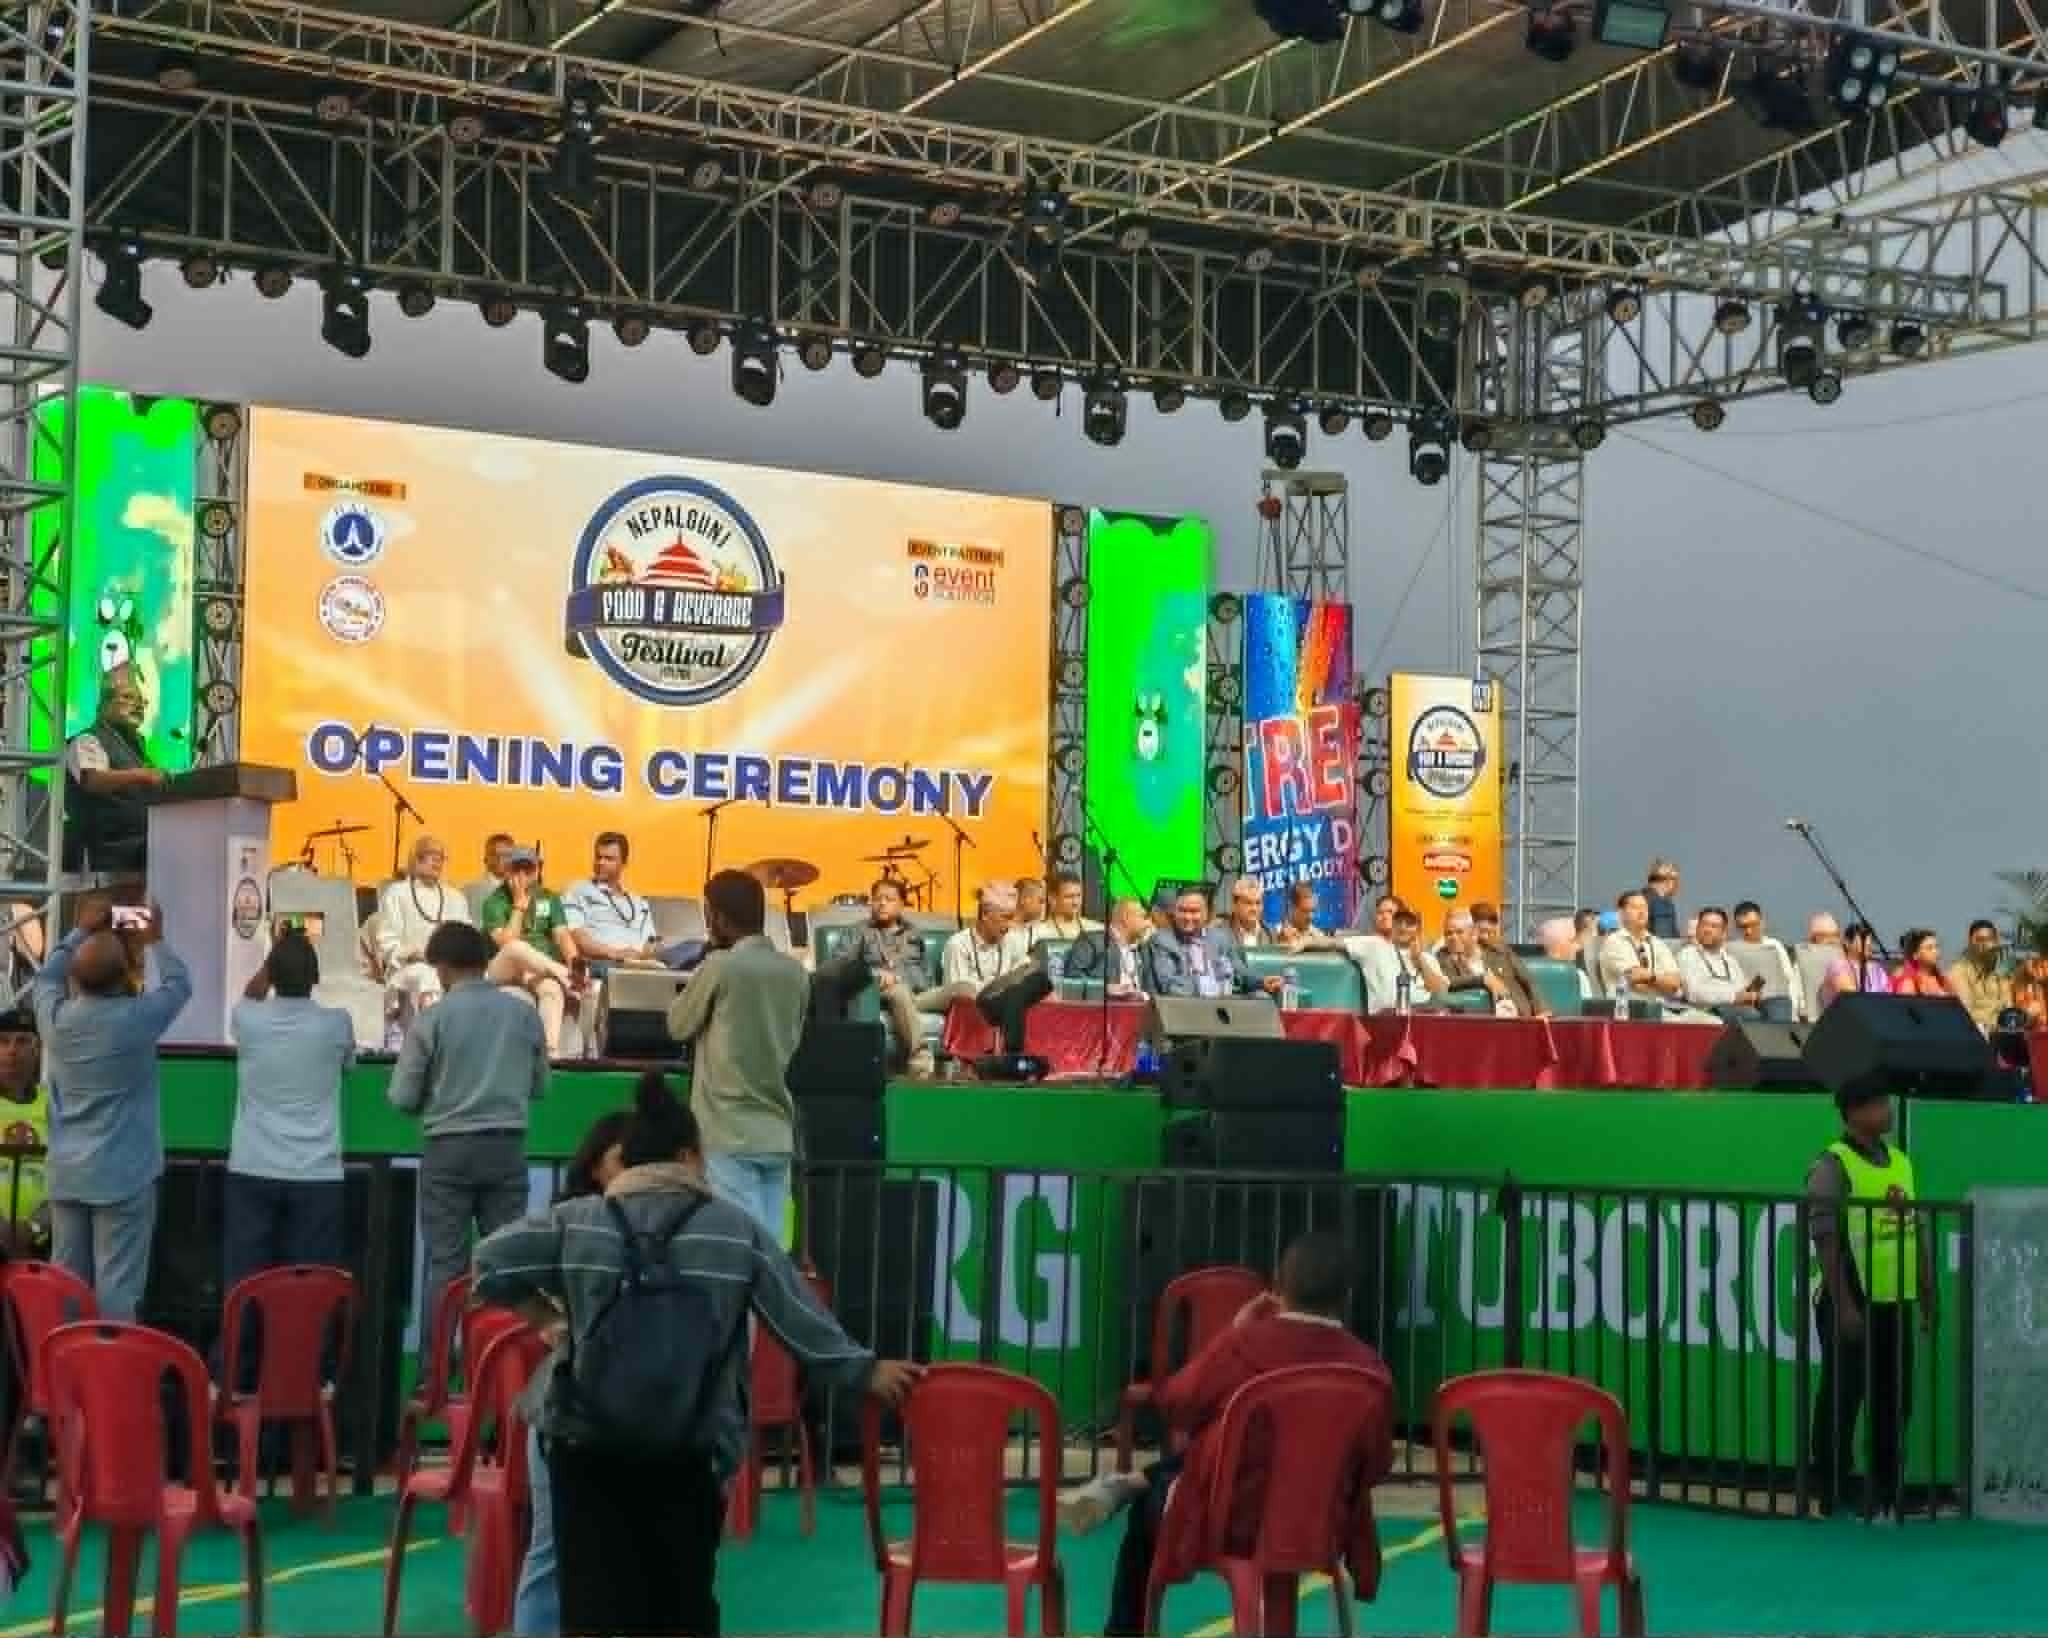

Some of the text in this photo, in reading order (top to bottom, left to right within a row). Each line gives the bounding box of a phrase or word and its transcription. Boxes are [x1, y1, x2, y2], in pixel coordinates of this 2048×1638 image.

[933, 566, 997, 589] event
[620, 632, 726, 668] Festival
[308, 723, 993, 816] OPENING CEREMONY
